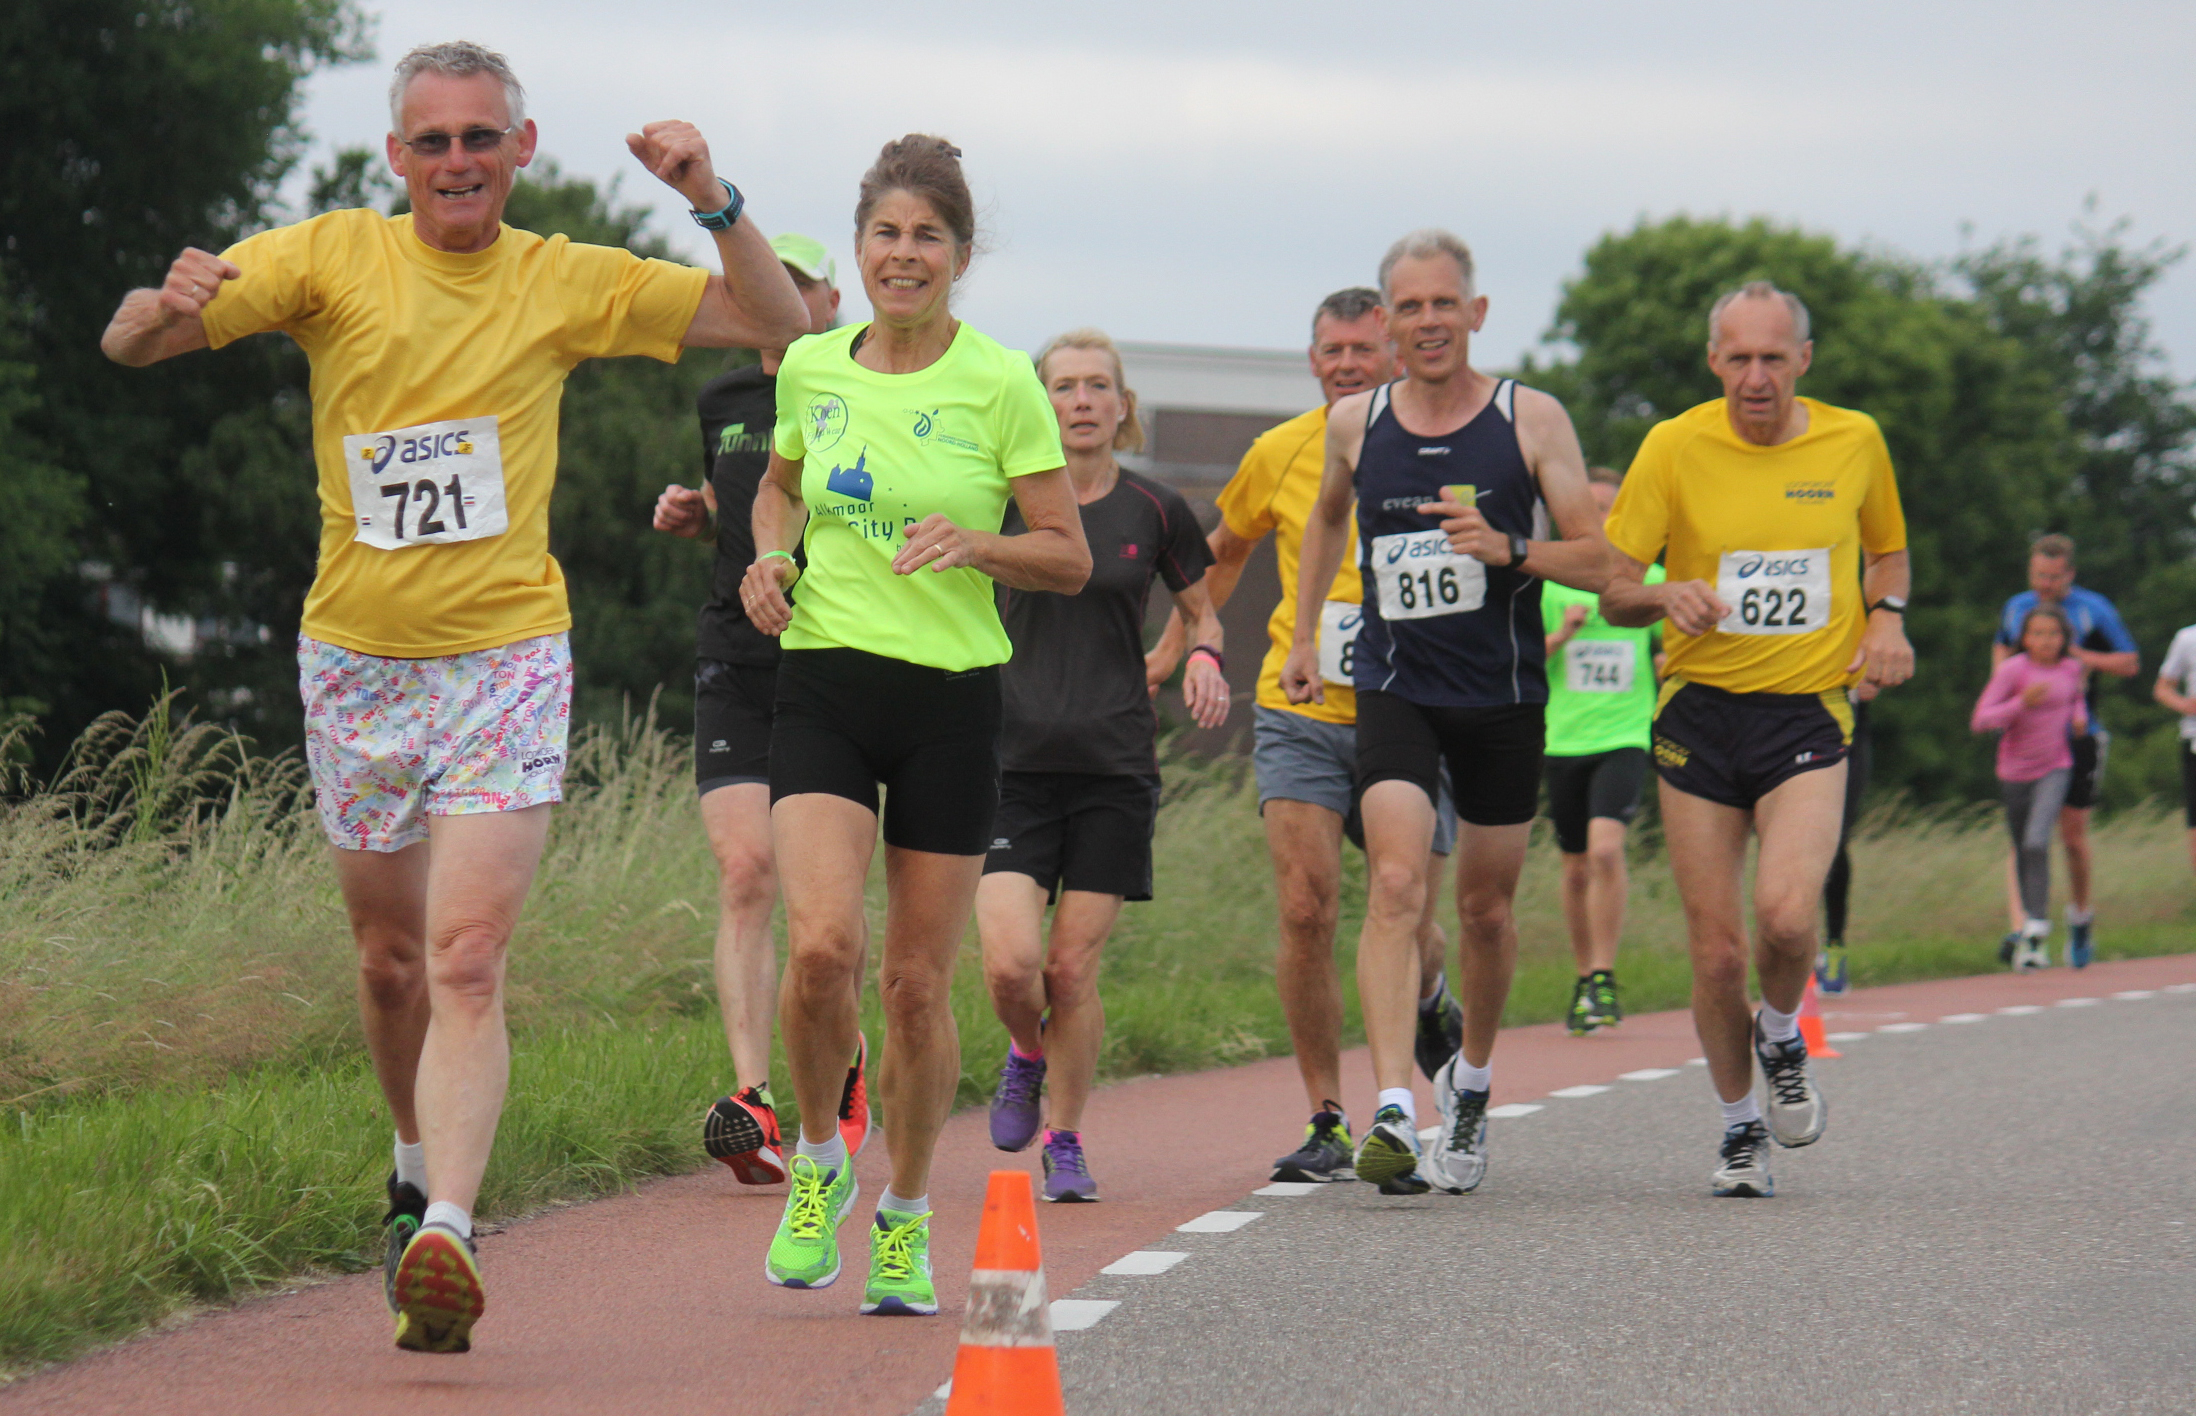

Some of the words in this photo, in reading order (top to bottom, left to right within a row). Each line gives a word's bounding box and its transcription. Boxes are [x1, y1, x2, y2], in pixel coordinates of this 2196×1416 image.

[380, 474, 467, 540] 721
[1399, 567, 1459, 609] 816
[1742, 587, 1807, 626] 622
[1580, 662, 1619, 687] 744
